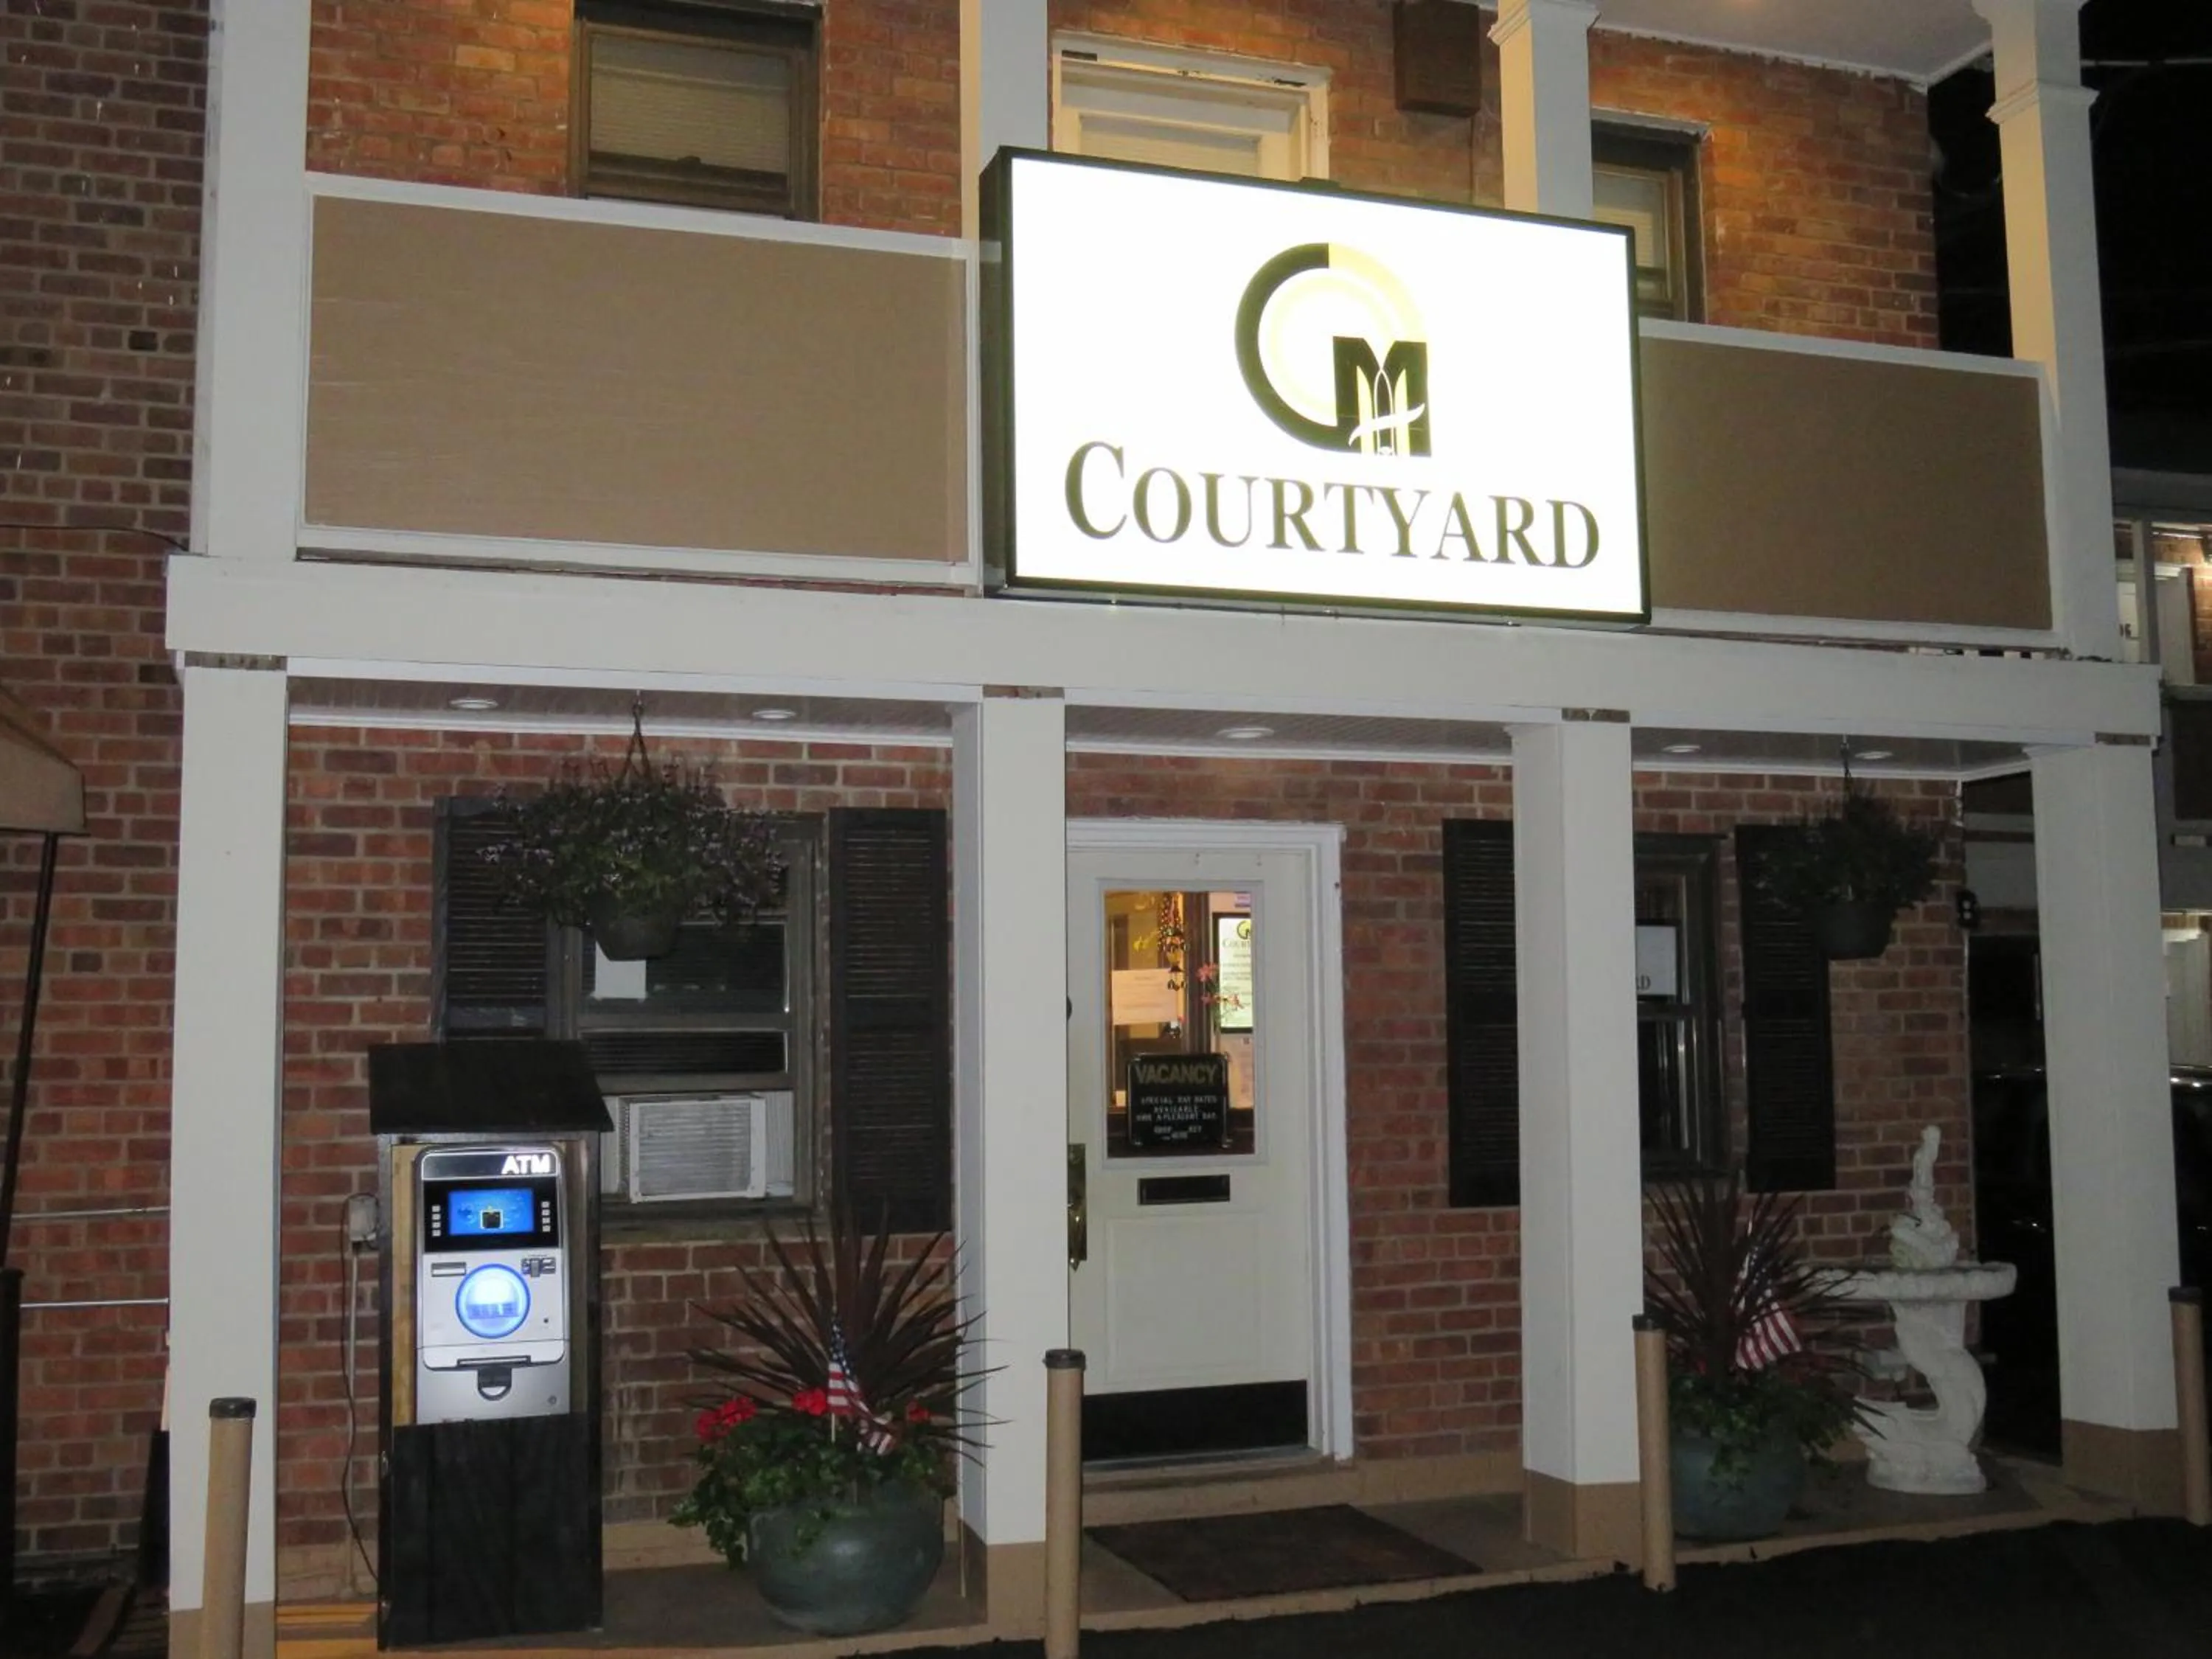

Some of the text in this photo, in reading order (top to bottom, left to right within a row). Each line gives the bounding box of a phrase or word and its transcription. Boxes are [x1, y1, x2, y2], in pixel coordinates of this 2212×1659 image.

[1065, 441, 1599, 568] COURTYARD
[1135, 1063, 1217, 1085] VACANCY
[501, 1154, 550, 1175] ATM
